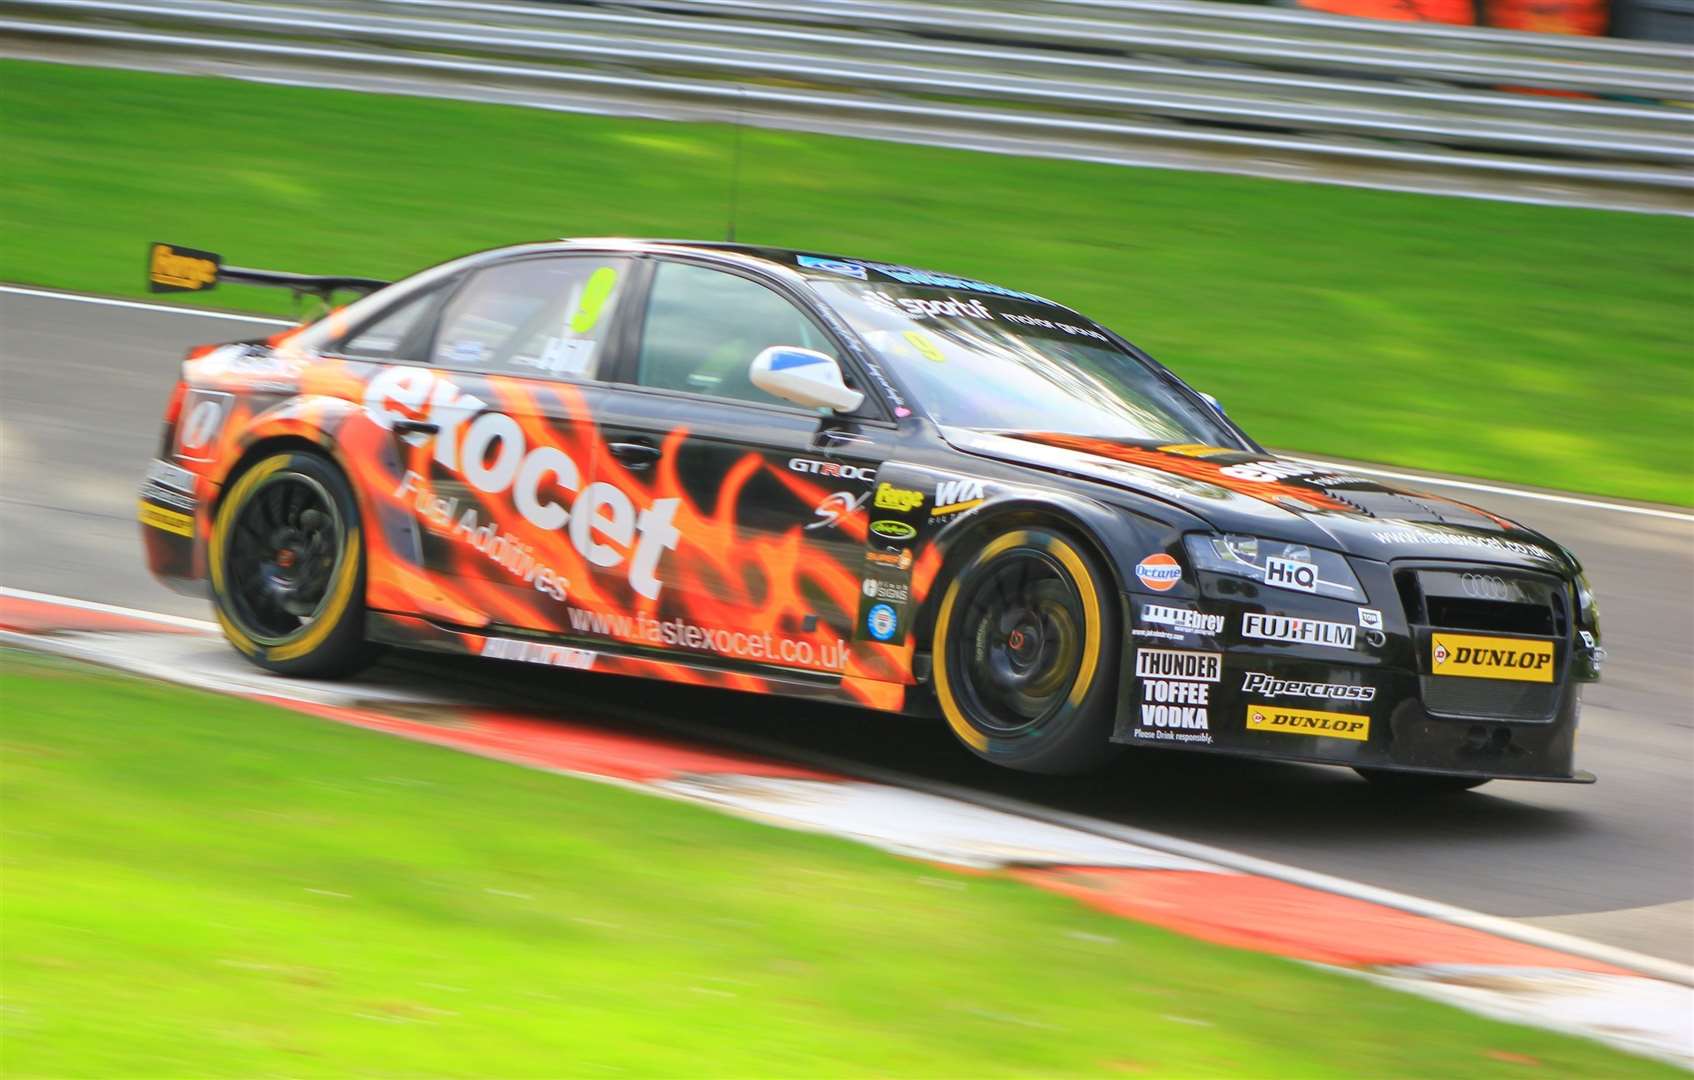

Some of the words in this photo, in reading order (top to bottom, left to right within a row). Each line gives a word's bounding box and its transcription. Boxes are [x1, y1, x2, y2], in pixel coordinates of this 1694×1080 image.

[570, 266, 617, 333] 9
[788, 457, 877, 482] GTROC
[364, 366, 680, 600] exocet
[394, 470, 460, 527] Fuel
[456, 508, 569, 602] Additives
[1135, 565, 1181, 579] Octane
[1267, 562, 1315, 588] HiQ
[566, 606, 851, 670] www.fastexocet.co.uk
[1245, 615, 1352, 646] FUJIFILM
[1140, 651, 1218, 679] THUNDER
[1455, 647, 1551, 669] DUNLOP
[1143, 679, 1209, 705] TOFFEE
[1241, 671, 1376, 701] Pipercross
[1141, 704, 1209, 730] VODKA
[1271, 713, 1364, 733] DUNLOP
[1134, 728, 1156, 739] Please
[1155, 730, 1175, 740] Drink
